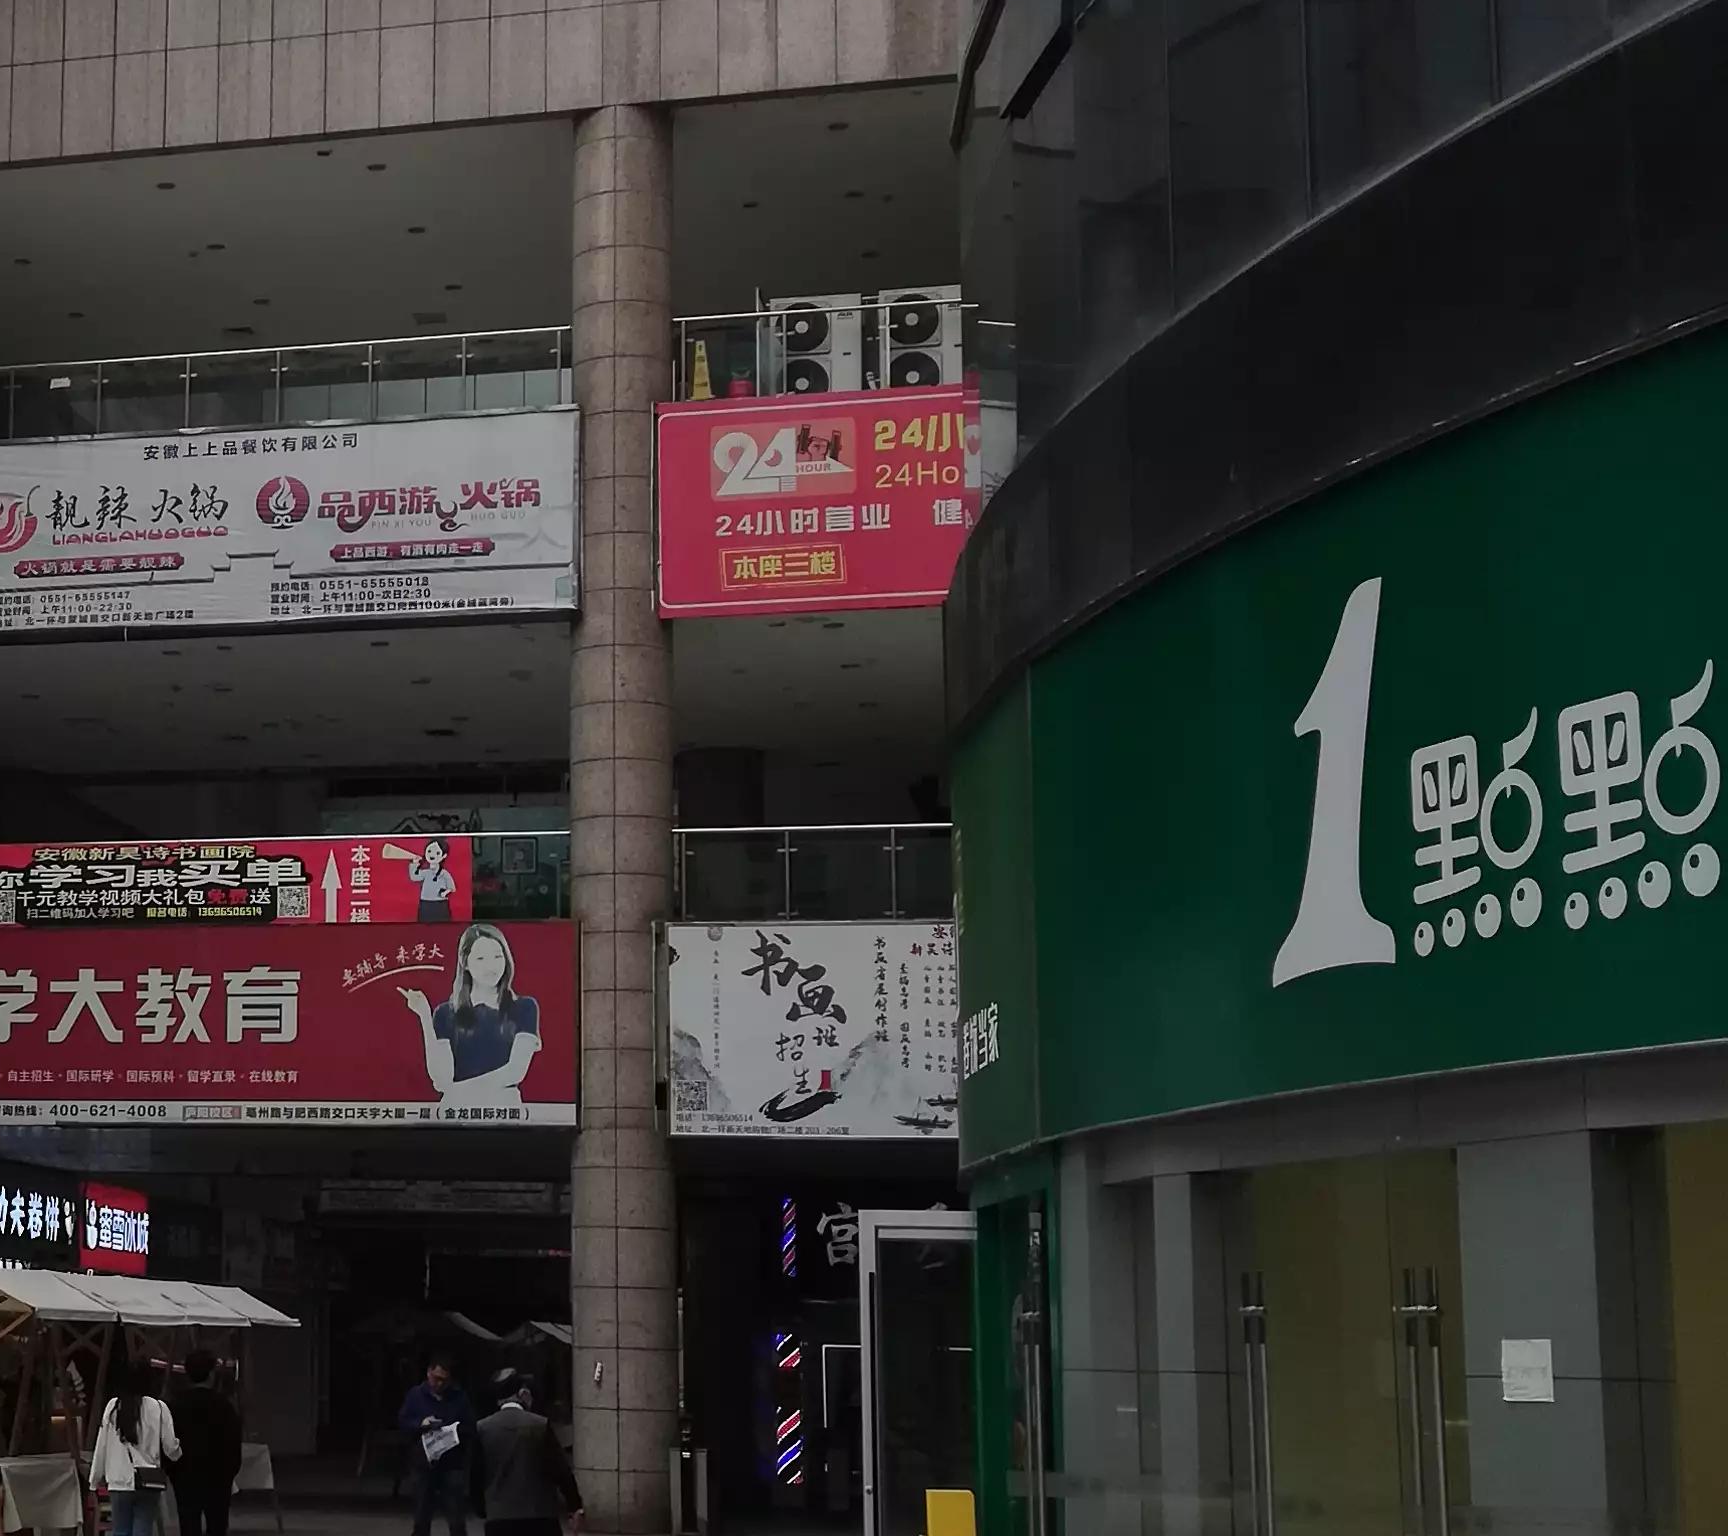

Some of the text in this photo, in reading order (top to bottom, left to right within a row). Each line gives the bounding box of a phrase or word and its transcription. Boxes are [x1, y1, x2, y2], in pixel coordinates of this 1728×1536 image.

[143, 432, 359, 461] 安徽上上品餐饮有限公司
[796, 463, 833, 475] HOUR
[408, 517, 432, 528] YOU
[715, 503, 892, 537] 24小时营业
[733, 550, 837, 580] 本座三楼
[16, 887, 272, 908] 千元教学视频大礼包免费送
[6, 1069, 55, 1084] 自主招生
[65, 1069, 115, 1084] 国际研学
[125, 1069, 176, 1084] 国际预科
[248, 1069, 299, 1085] 在线教育
[98, 1204, 150, 1254] 蜜雪冰城
